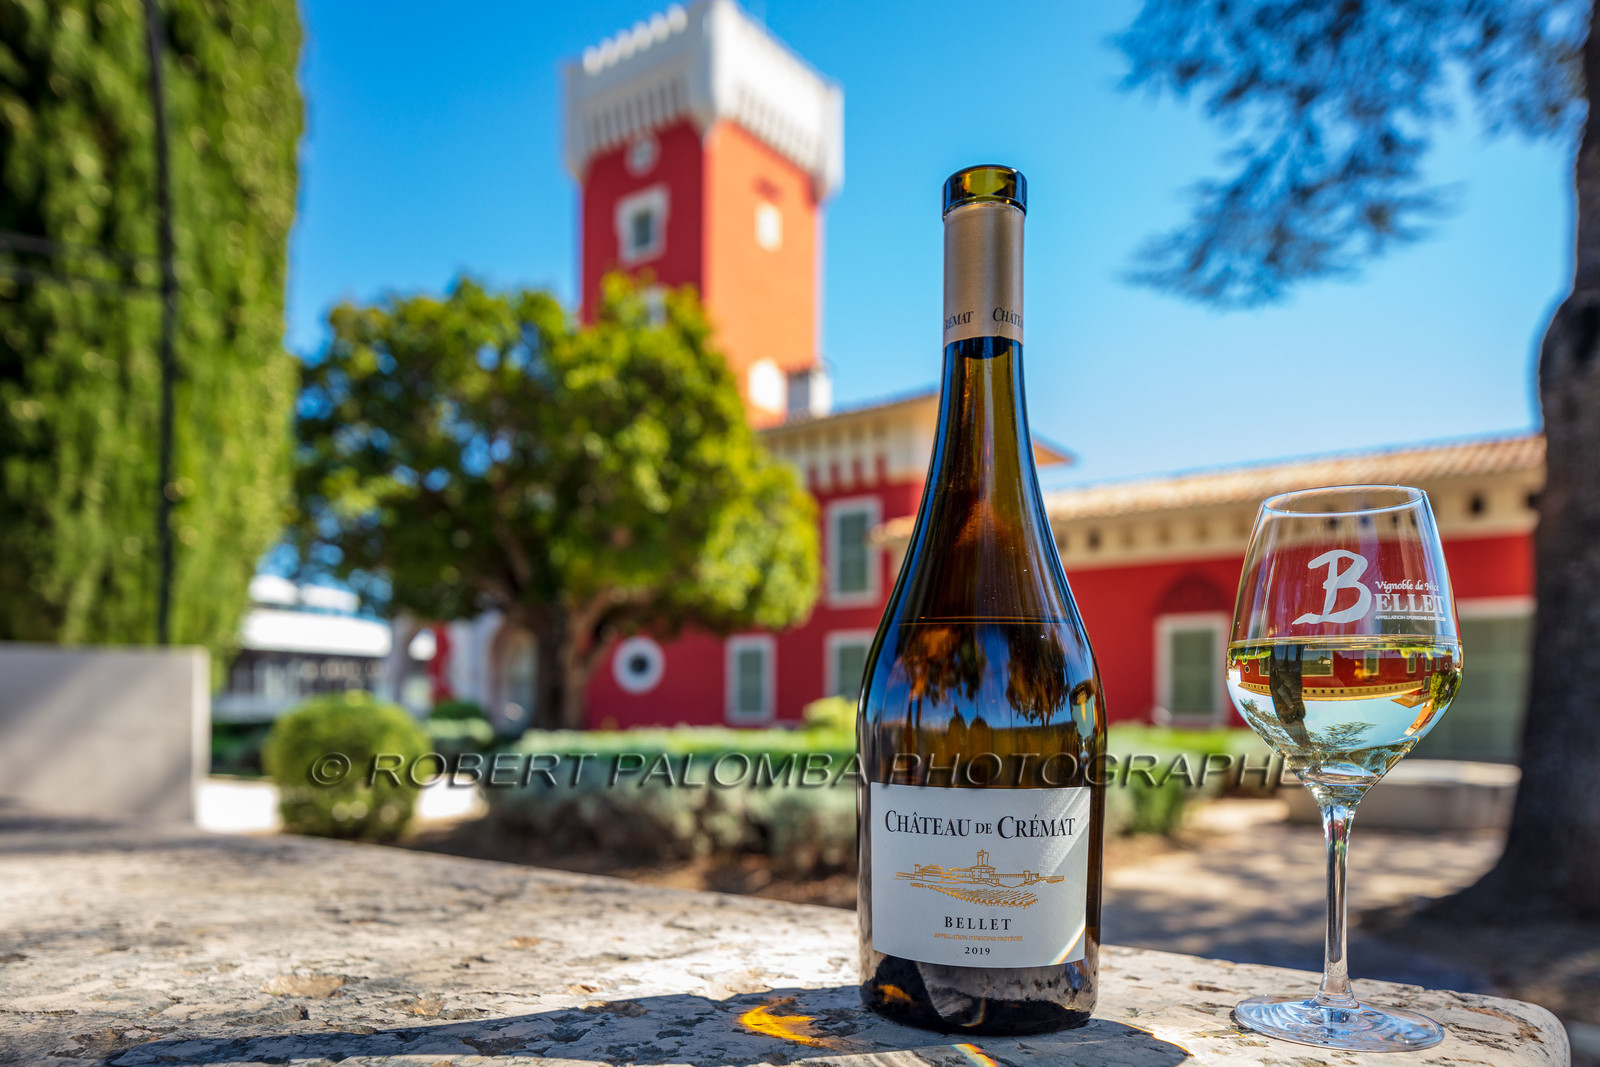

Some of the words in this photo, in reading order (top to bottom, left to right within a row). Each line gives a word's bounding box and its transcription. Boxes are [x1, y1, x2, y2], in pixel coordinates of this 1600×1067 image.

[945, 310, 974, 330] RÉMAT
[993, 307, 1023, 328] CHÂTE
[1375, 579, 1413, 593] Vignoble
[1415, 580, 1423, 591] de
[884, 809, 972, 837] CHÂTEAU
[975, 822, 993, 835] DE
[997, 814, 1076, 840] CRÉMAT
[944, 916, 1012, 931] BELLET
[933, 932, 968, 941] APPELLATION
[964, 946, 991, 955] 2019
